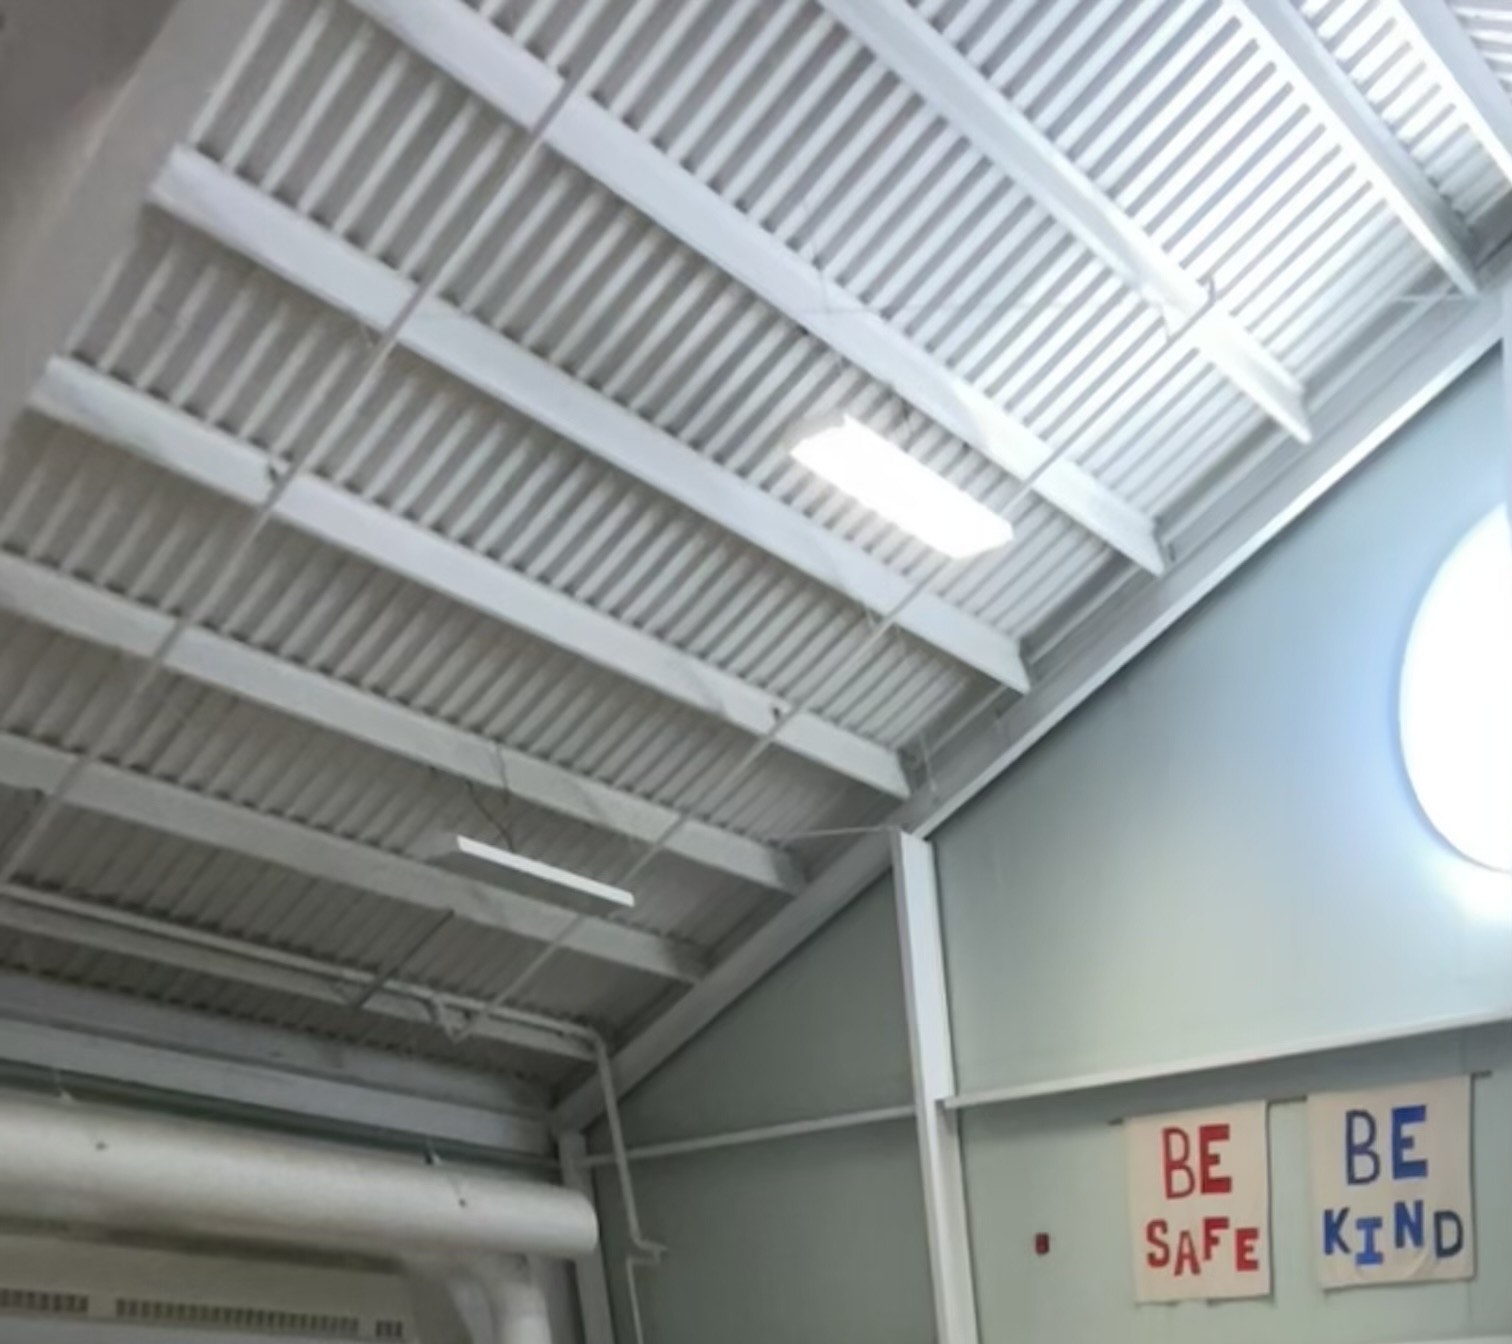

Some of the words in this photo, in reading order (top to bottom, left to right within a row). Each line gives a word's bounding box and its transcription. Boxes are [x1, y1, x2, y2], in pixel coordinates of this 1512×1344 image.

[1162, 1123, 1233, 1200] BE
[1345, 1104, 1429, 1185] BE
[1146, 1217, 1260, 1276] SAFE
[1323, 1200, 1464, 1266] KIND
